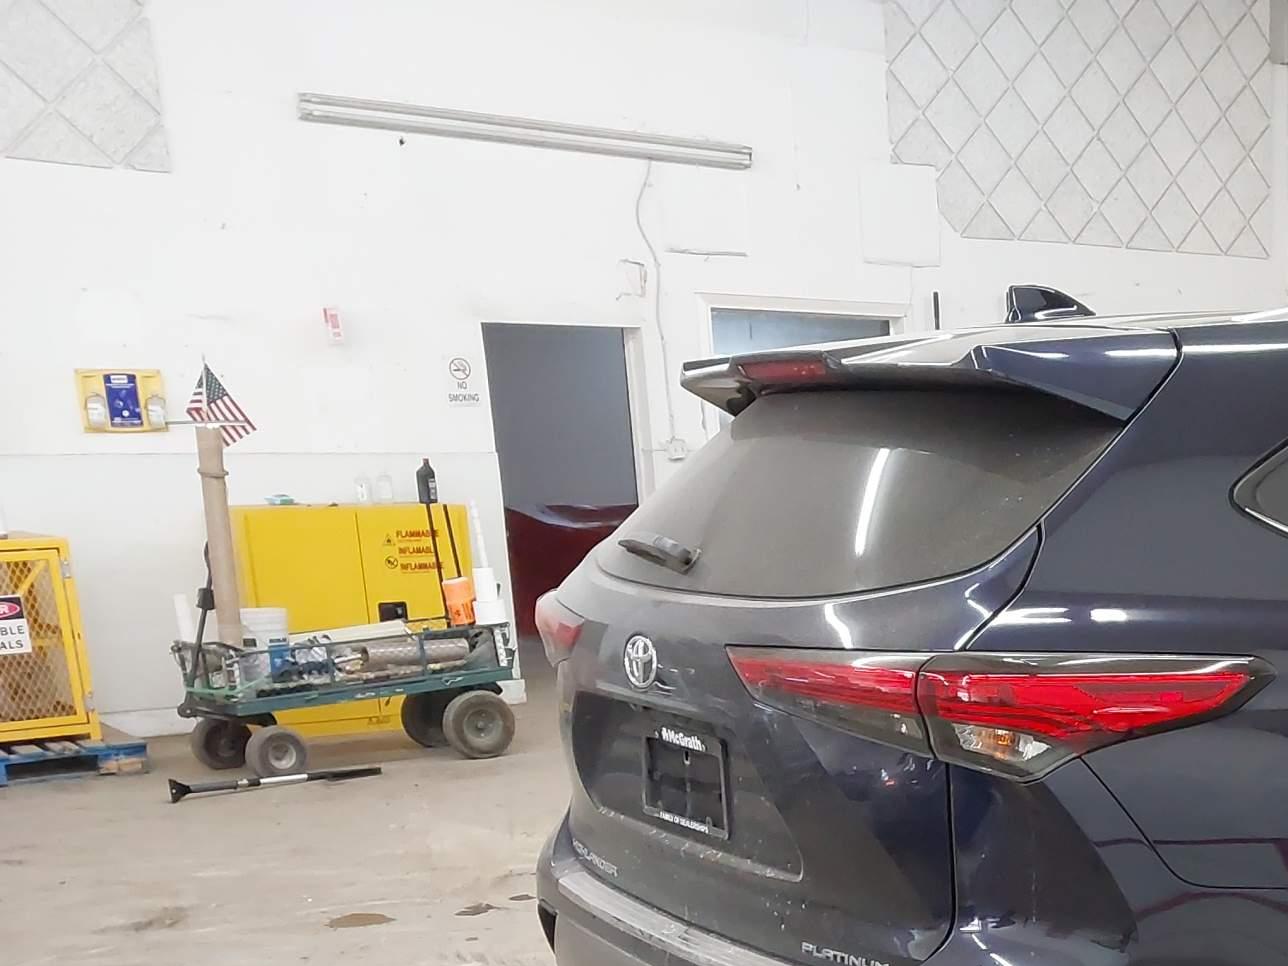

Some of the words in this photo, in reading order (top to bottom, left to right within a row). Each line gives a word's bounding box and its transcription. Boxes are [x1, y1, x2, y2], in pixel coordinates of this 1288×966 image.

[457, 381, 468, 389] NO
[448, 393, 480, 402] SMOKING
[396, 529, 439, 538] FLAMMABE
[400, 561, 444, 570] INFLAMMABE
[667, 728, 703, 751] McGrath
